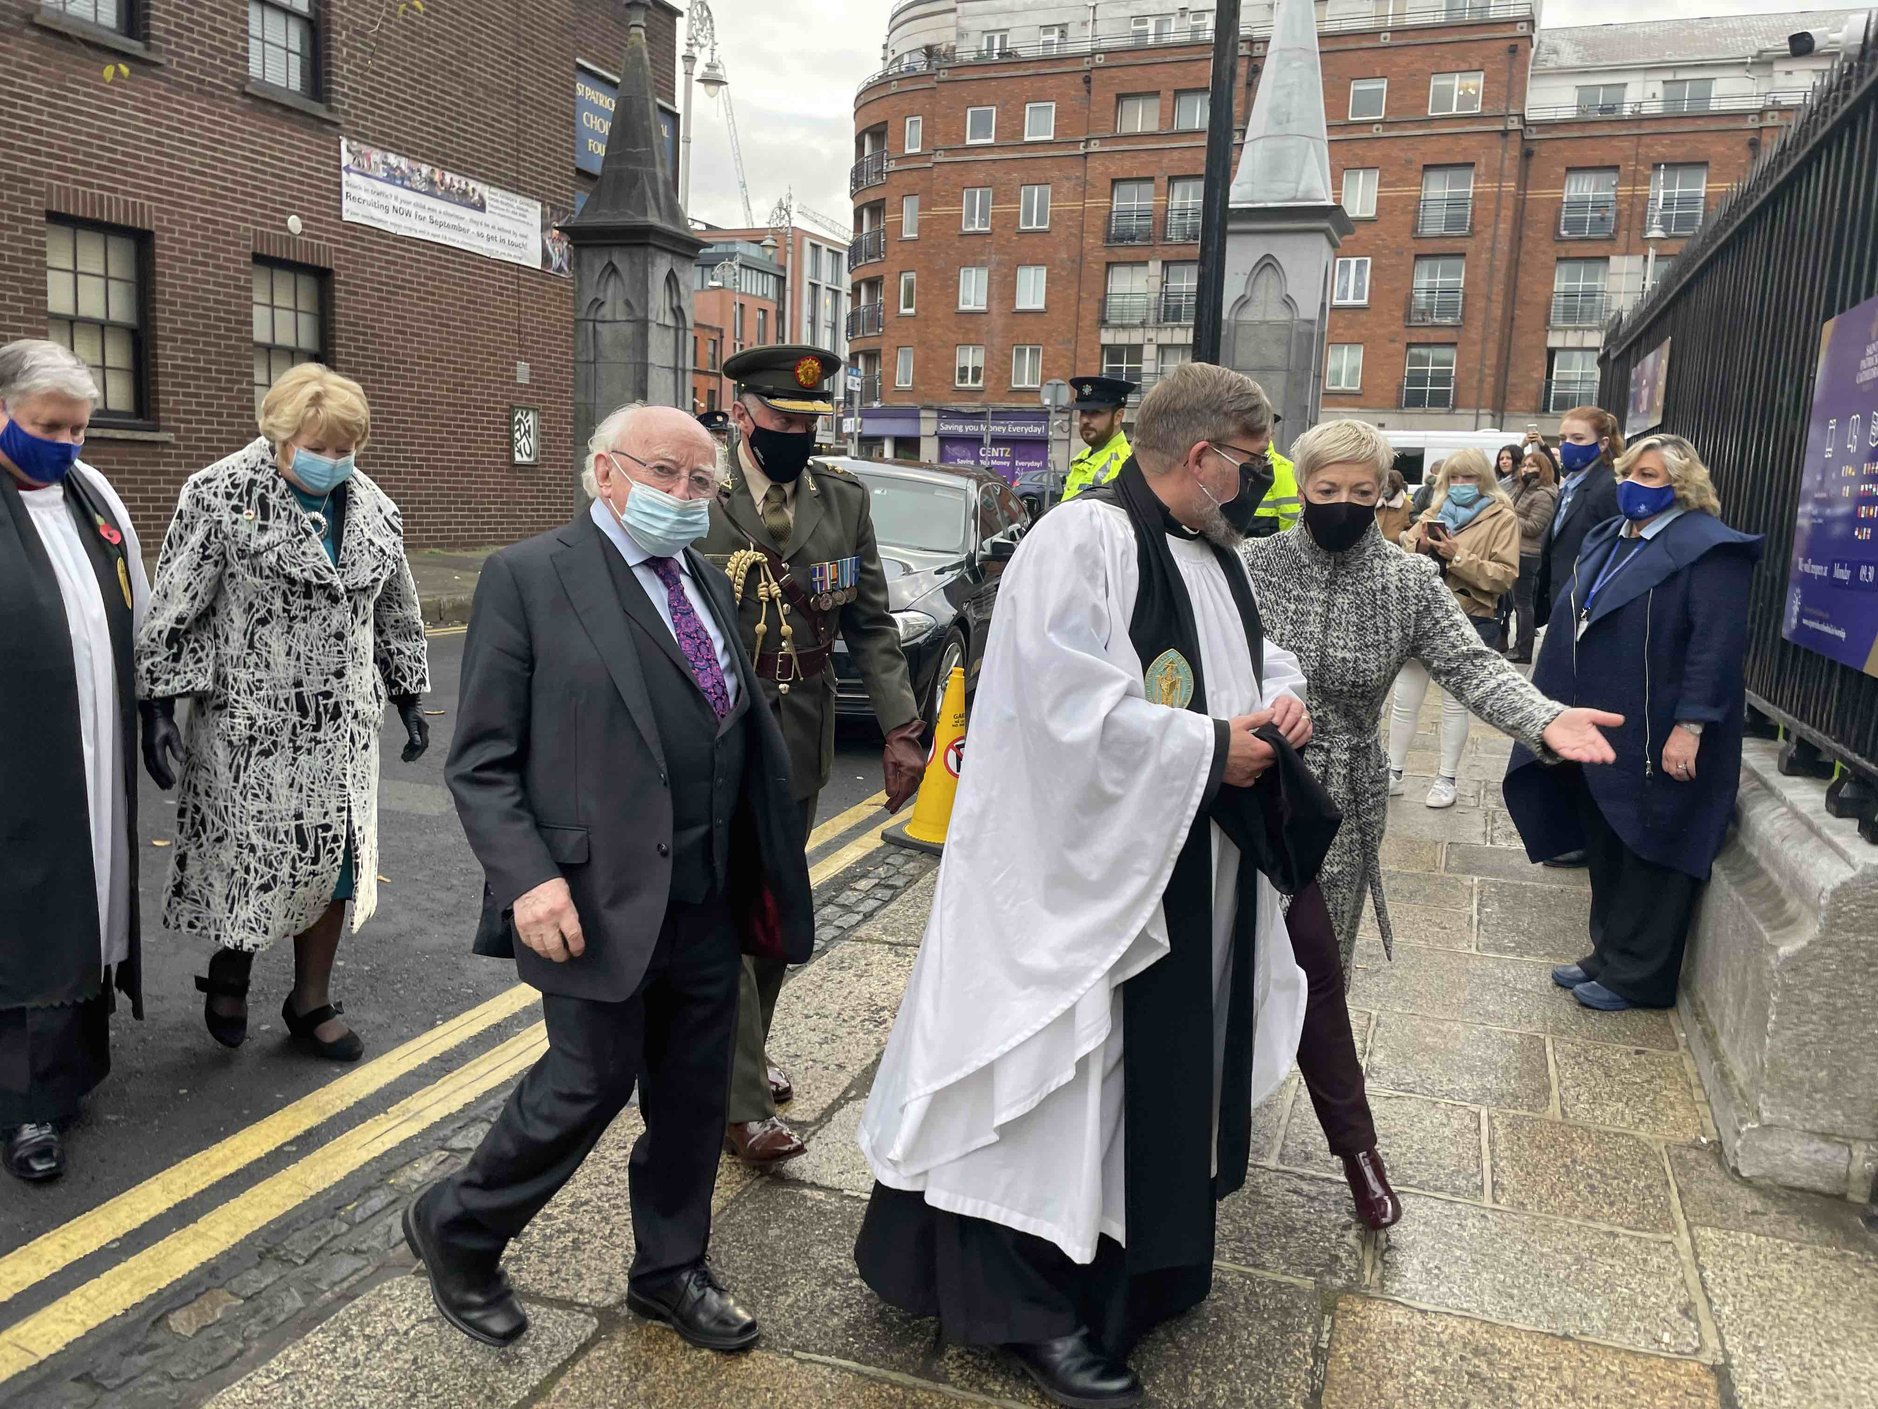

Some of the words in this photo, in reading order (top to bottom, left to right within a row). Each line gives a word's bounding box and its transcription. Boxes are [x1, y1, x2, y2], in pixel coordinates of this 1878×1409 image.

[583, 111, 611, 136] CHOI
[345, 191, 390, 215] Recruiting
[392, 204, 413, 218] NOW
[414, 211, 427, 223] for
[428, 215, 471, 235] September
[476, 231, 485, 239] so
[486, 232, 498, 243] get
[500, 236, 506, 245] in
[507, 237, 528, 250] touch!
[940, 422, 964, 433] Saving
[964, 425, 979, 433] you
[1008, 424, 1045, 435] Everyday!
[979, 447, 1011, 458] CENTZ
[956, 458, 975, 466] Saving
[1015, 460, 1043, 468] Everyday!
[1833, 562, 1851, 585] Monday
